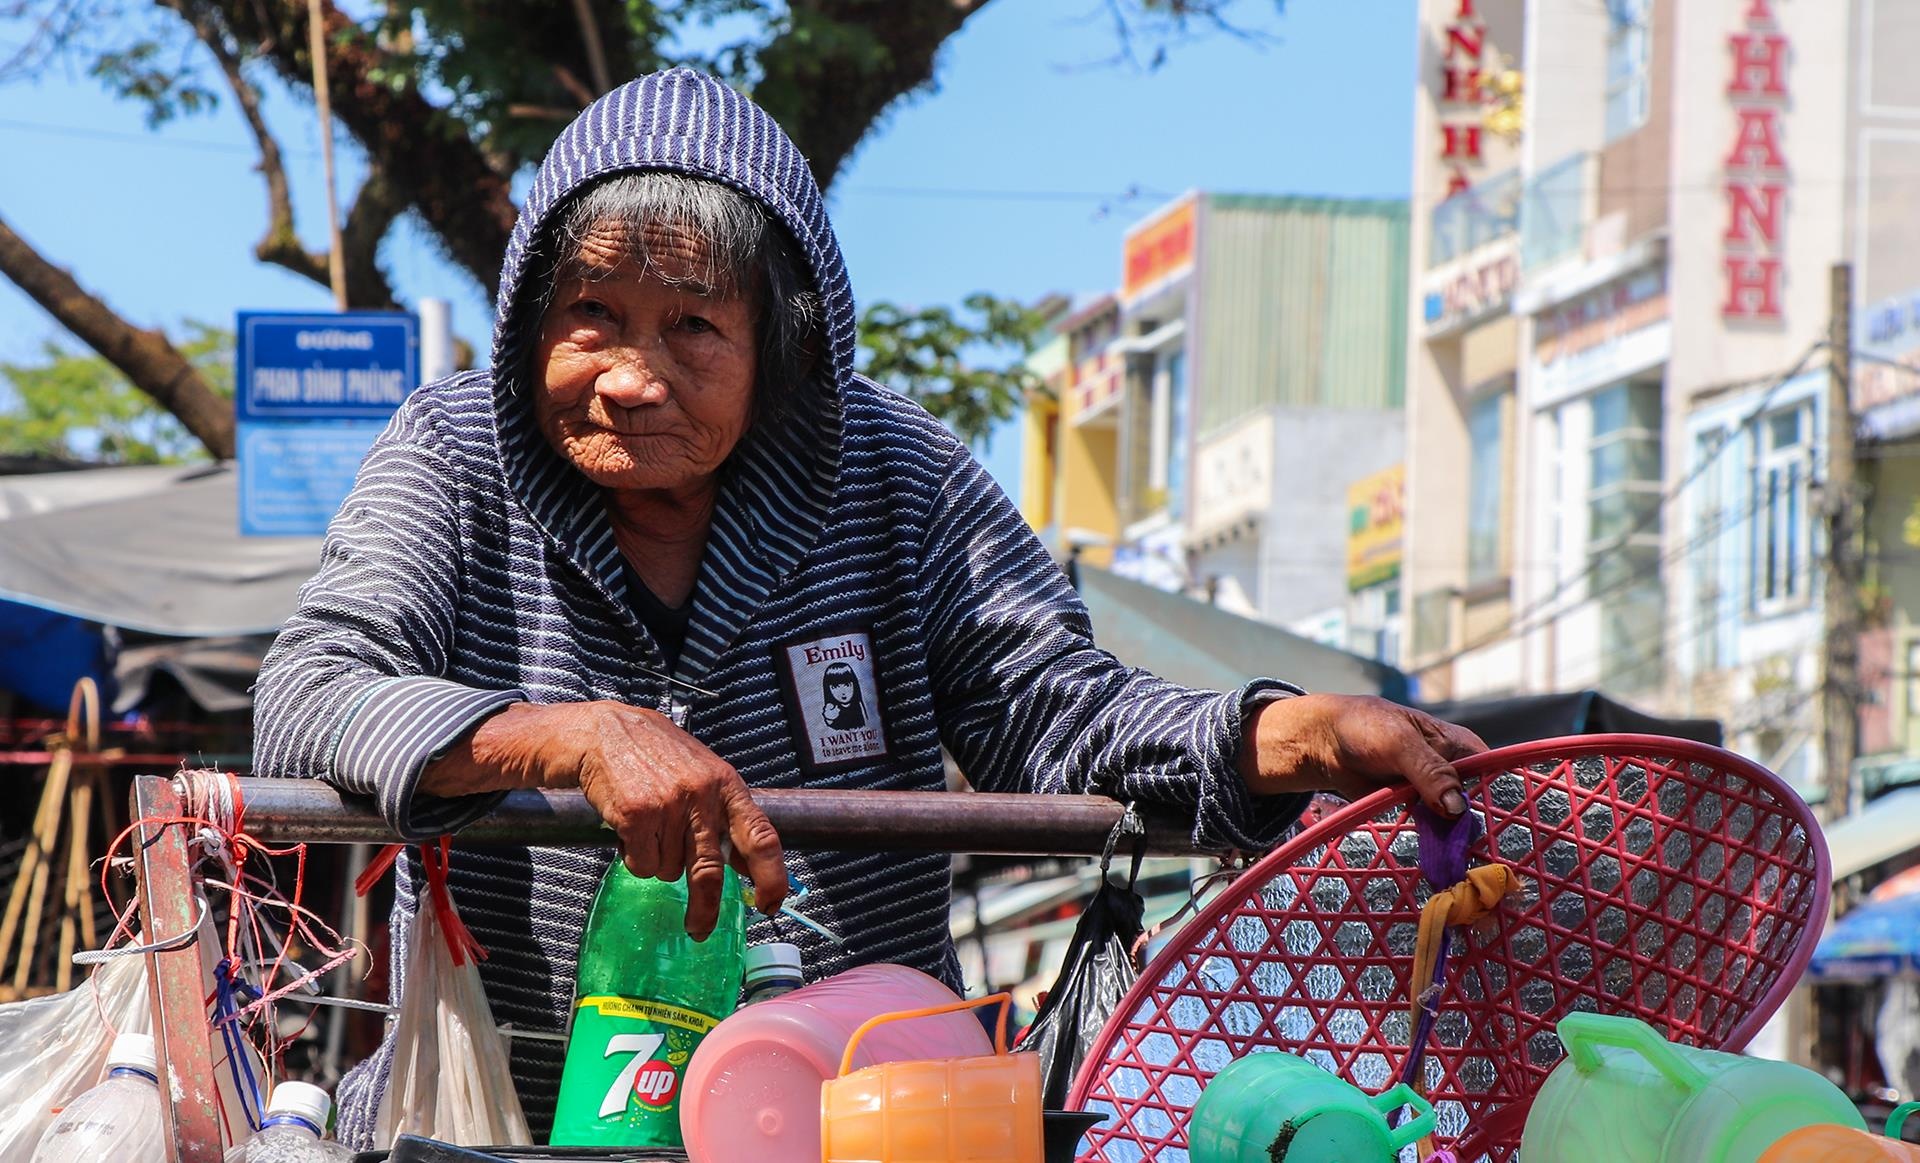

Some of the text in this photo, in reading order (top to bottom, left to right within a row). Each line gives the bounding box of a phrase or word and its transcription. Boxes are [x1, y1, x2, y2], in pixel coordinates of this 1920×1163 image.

[804, 640, 865, 665] Emily
[828, 731, 858, 746] WANT
[860, 728, 878, 742] YOU
[822, 748, 831, 758] to
[832, 746, 851, 757] leave
[622, 1002, 644, 1013] CHANH
